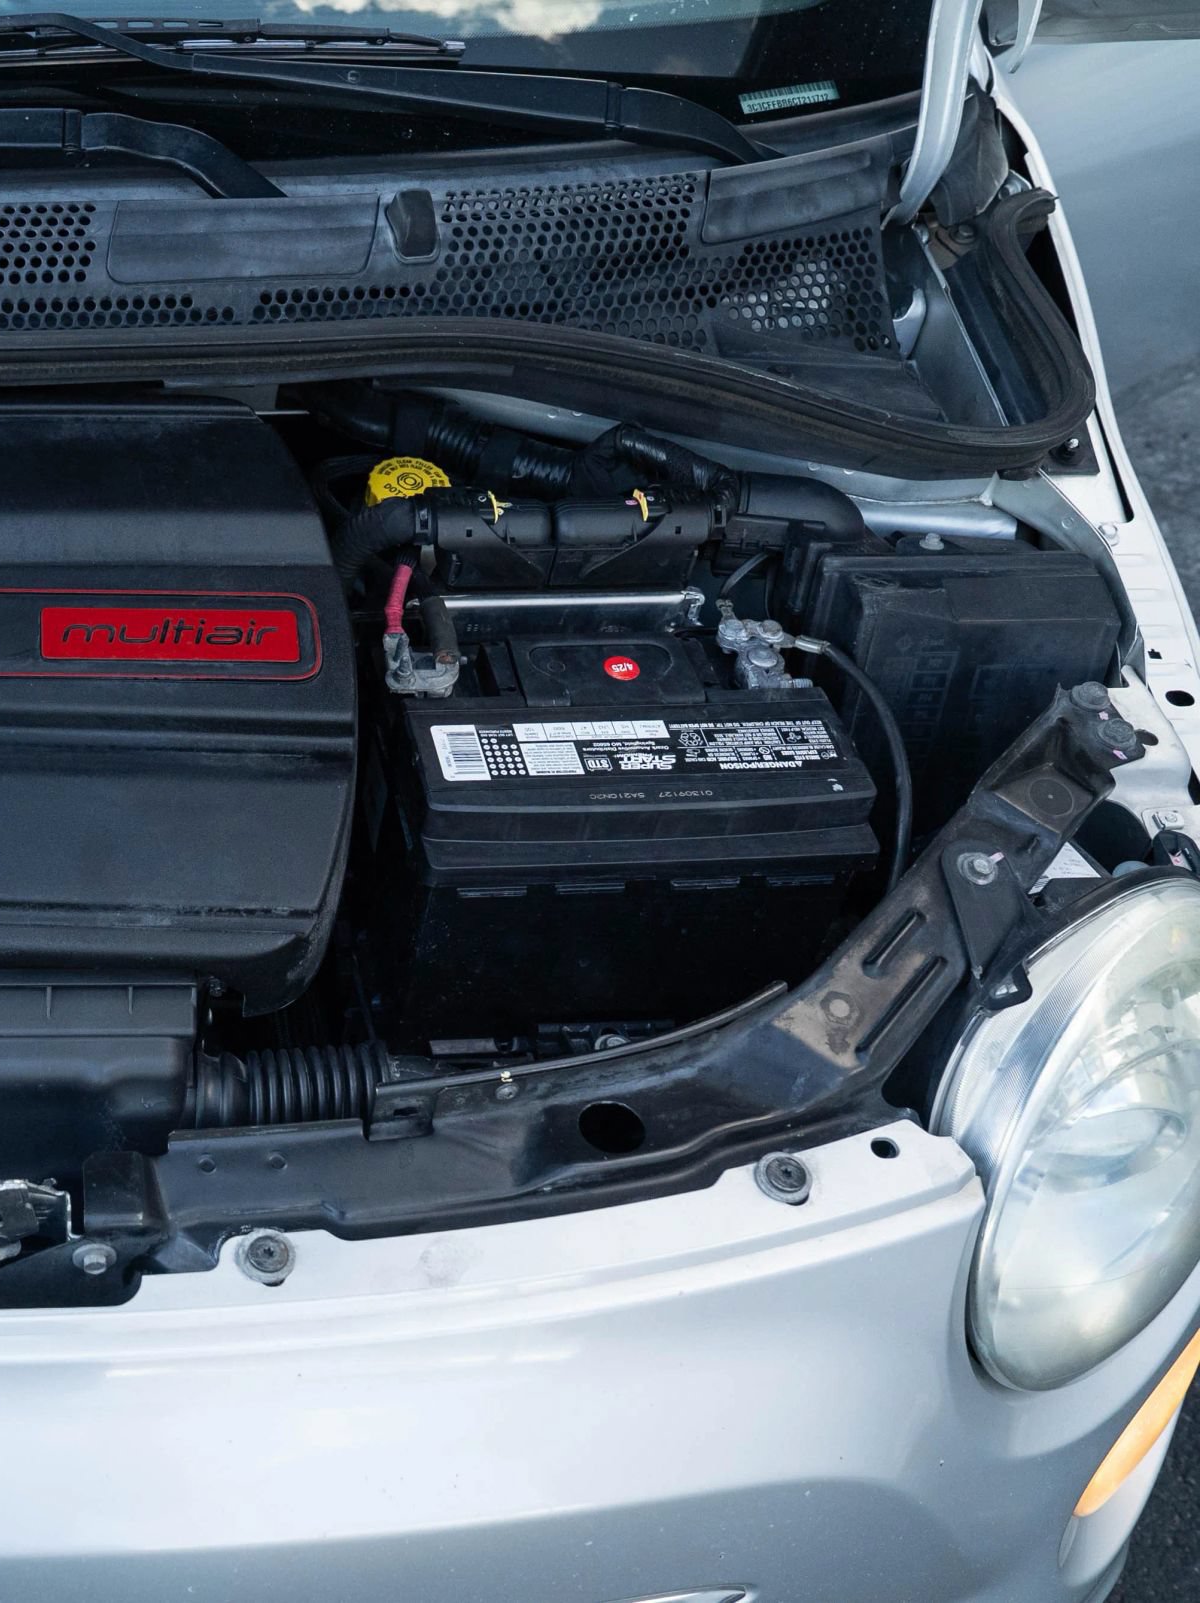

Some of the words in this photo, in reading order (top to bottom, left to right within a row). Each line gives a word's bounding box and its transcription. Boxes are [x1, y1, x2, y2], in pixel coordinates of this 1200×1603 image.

[415, 461, 433, 470] FILLER
[61, 617, 280, 645] multiair
[611, 662, 633, 673] 4/25
[618, 755, 676, 764] START
[588, 760, 609, 769] STD
[719, 761, 797, 769] DANGER/POISON
